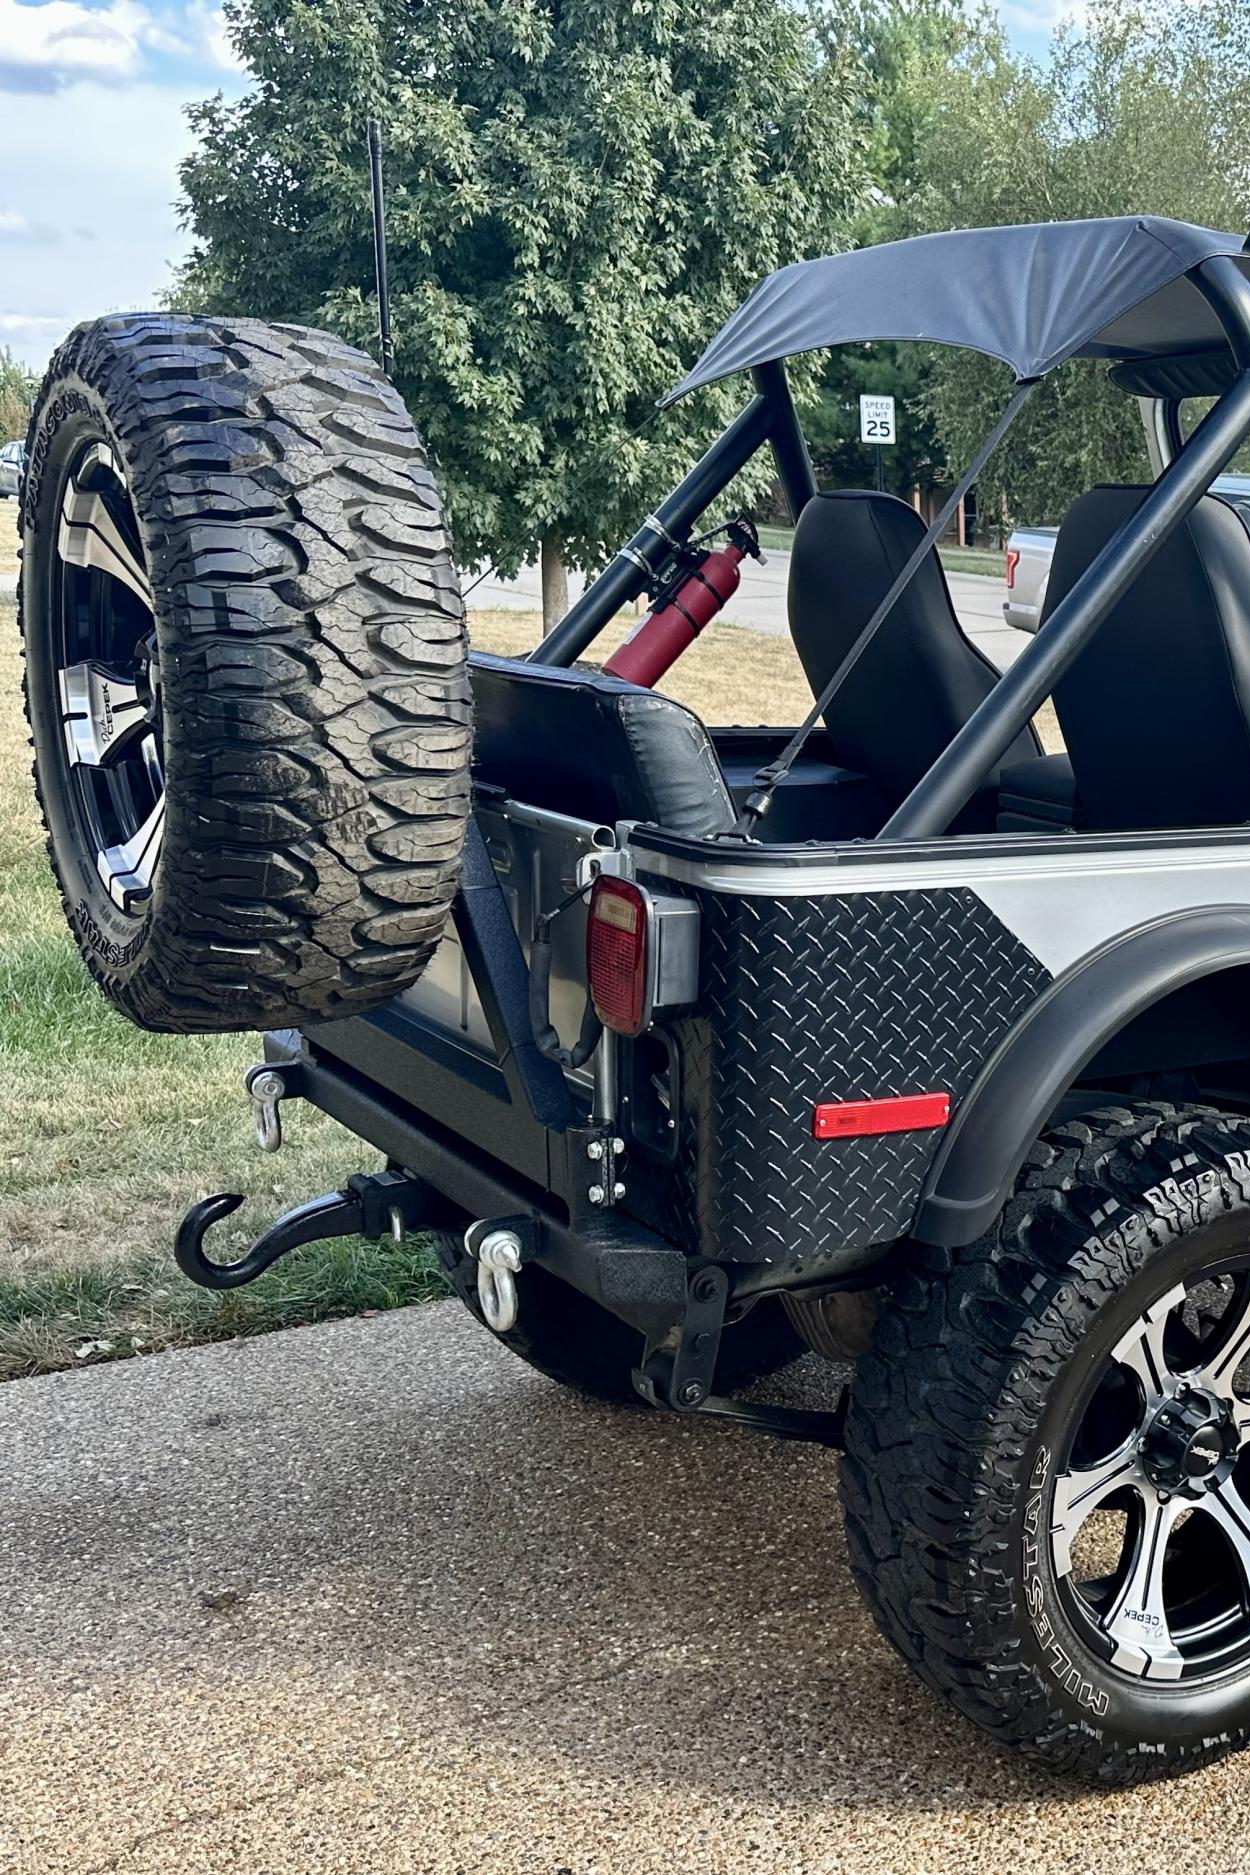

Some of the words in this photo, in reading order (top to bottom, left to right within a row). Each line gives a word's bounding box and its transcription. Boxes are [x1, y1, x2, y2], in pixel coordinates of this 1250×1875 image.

[865, 401, 891, 410] SPEED
[867, 411, 888, 419] LIMIT
[866, 420, 890, 437] 25
[101, 682, 114, 735] CEPEK
[1021, 1444, 1110, 1717] MILESTAR
[1123, 1607, 1160, 1627] CEPEK
